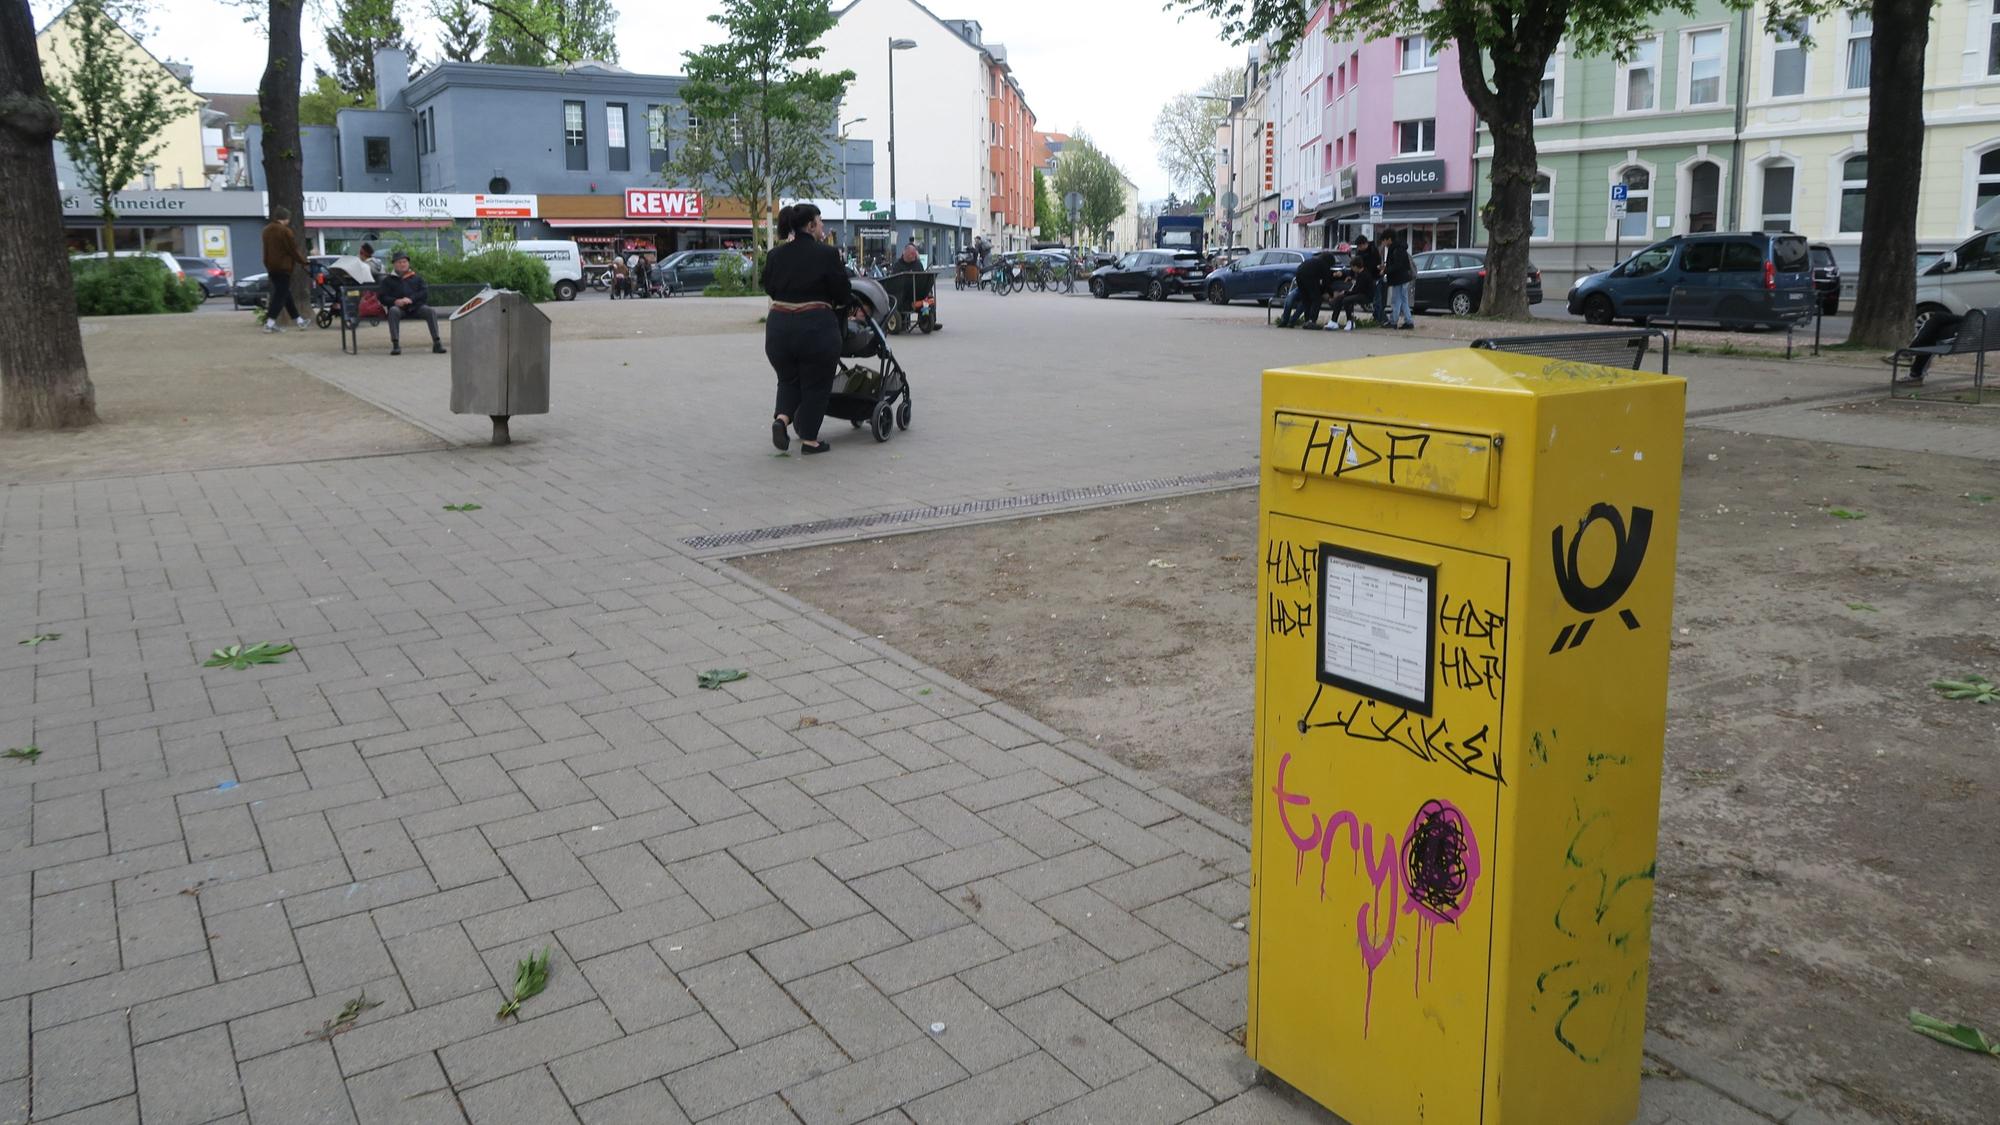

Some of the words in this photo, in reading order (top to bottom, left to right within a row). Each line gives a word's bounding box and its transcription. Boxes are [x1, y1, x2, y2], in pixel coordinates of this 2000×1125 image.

[1613, 186, 1623, 199] P
[93, 196, 186, 210] Shneider
[418, 196, 448, 208] KÖLN
[630, 192, 699, 213] REWE
[1284, 200, 1292, 209] P
[1372, 195, 1380, 206] P
[525, 251, 570, 260] nterprise
[1300, 419, 1431, 484] HDF
